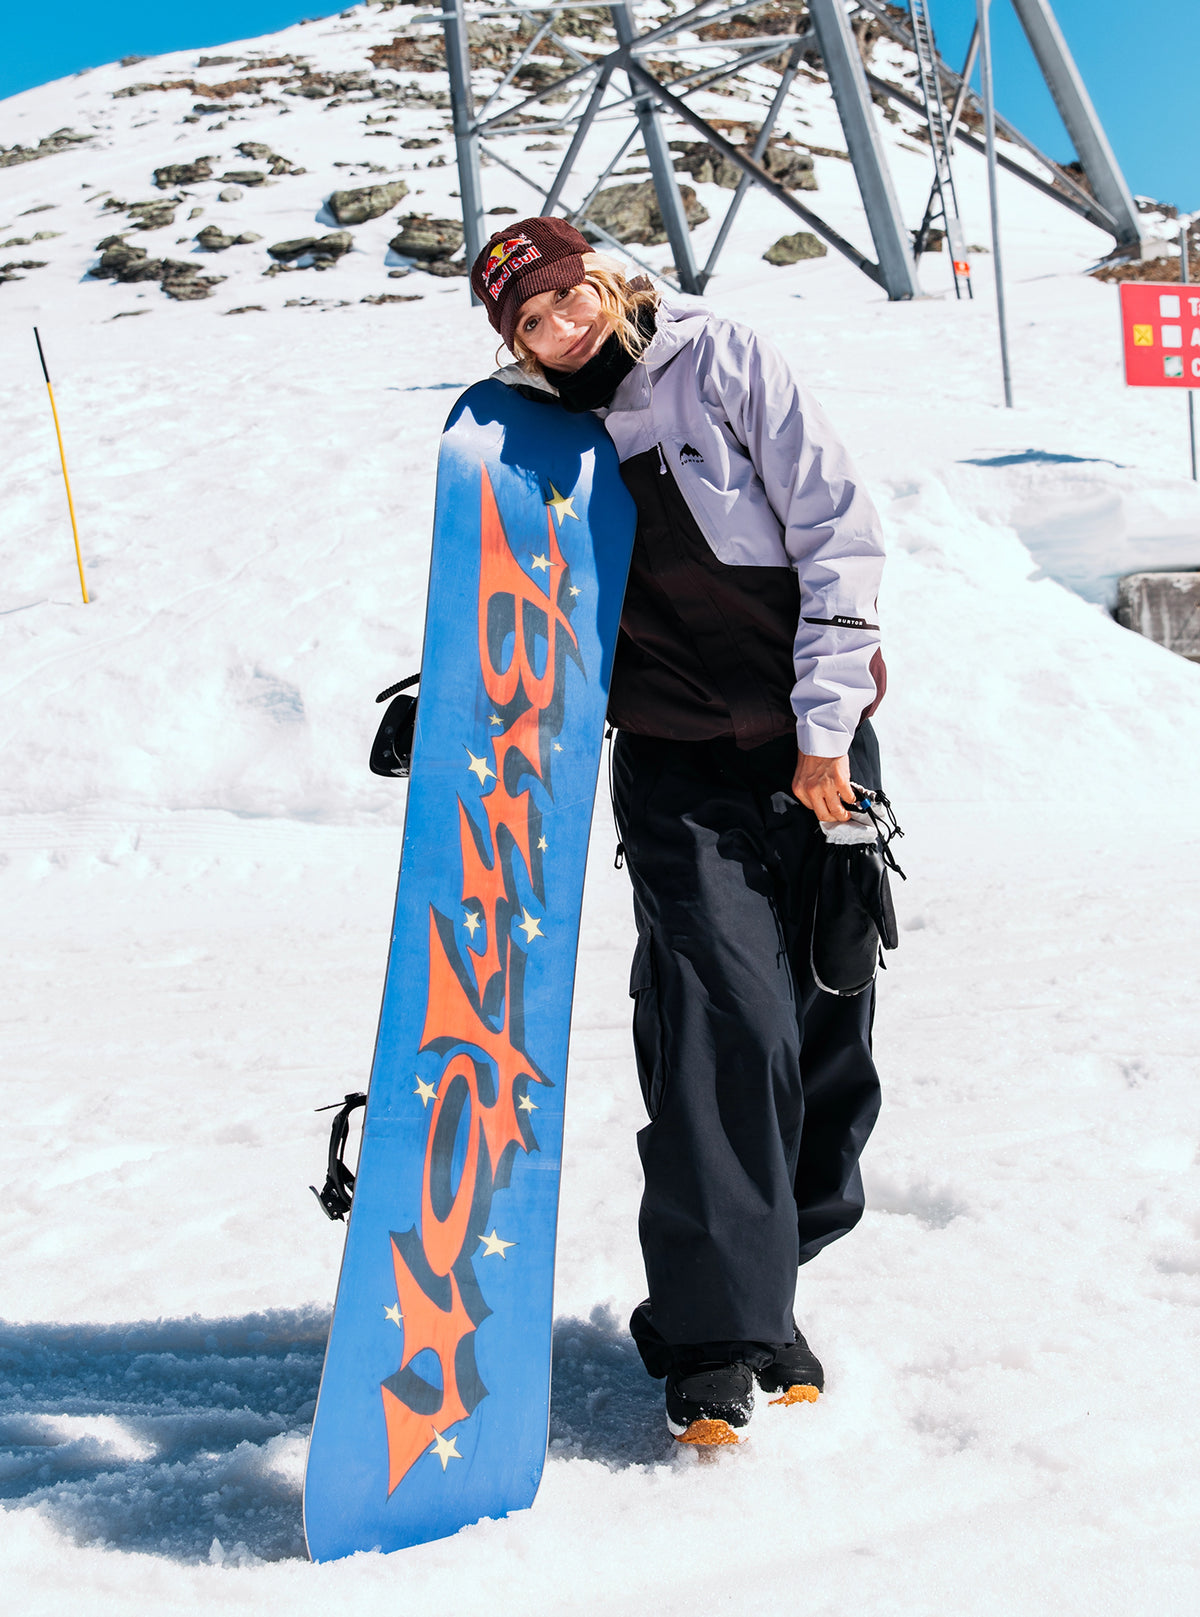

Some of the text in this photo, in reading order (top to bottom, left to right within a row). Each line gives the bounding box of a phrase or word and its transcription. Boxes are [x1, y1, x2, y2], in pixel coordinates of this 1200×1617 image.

[489, 245, 542, 300] Red Bull
[1188, 297, 1200, 316] T
[837, 618, 863, 626] BURTON
